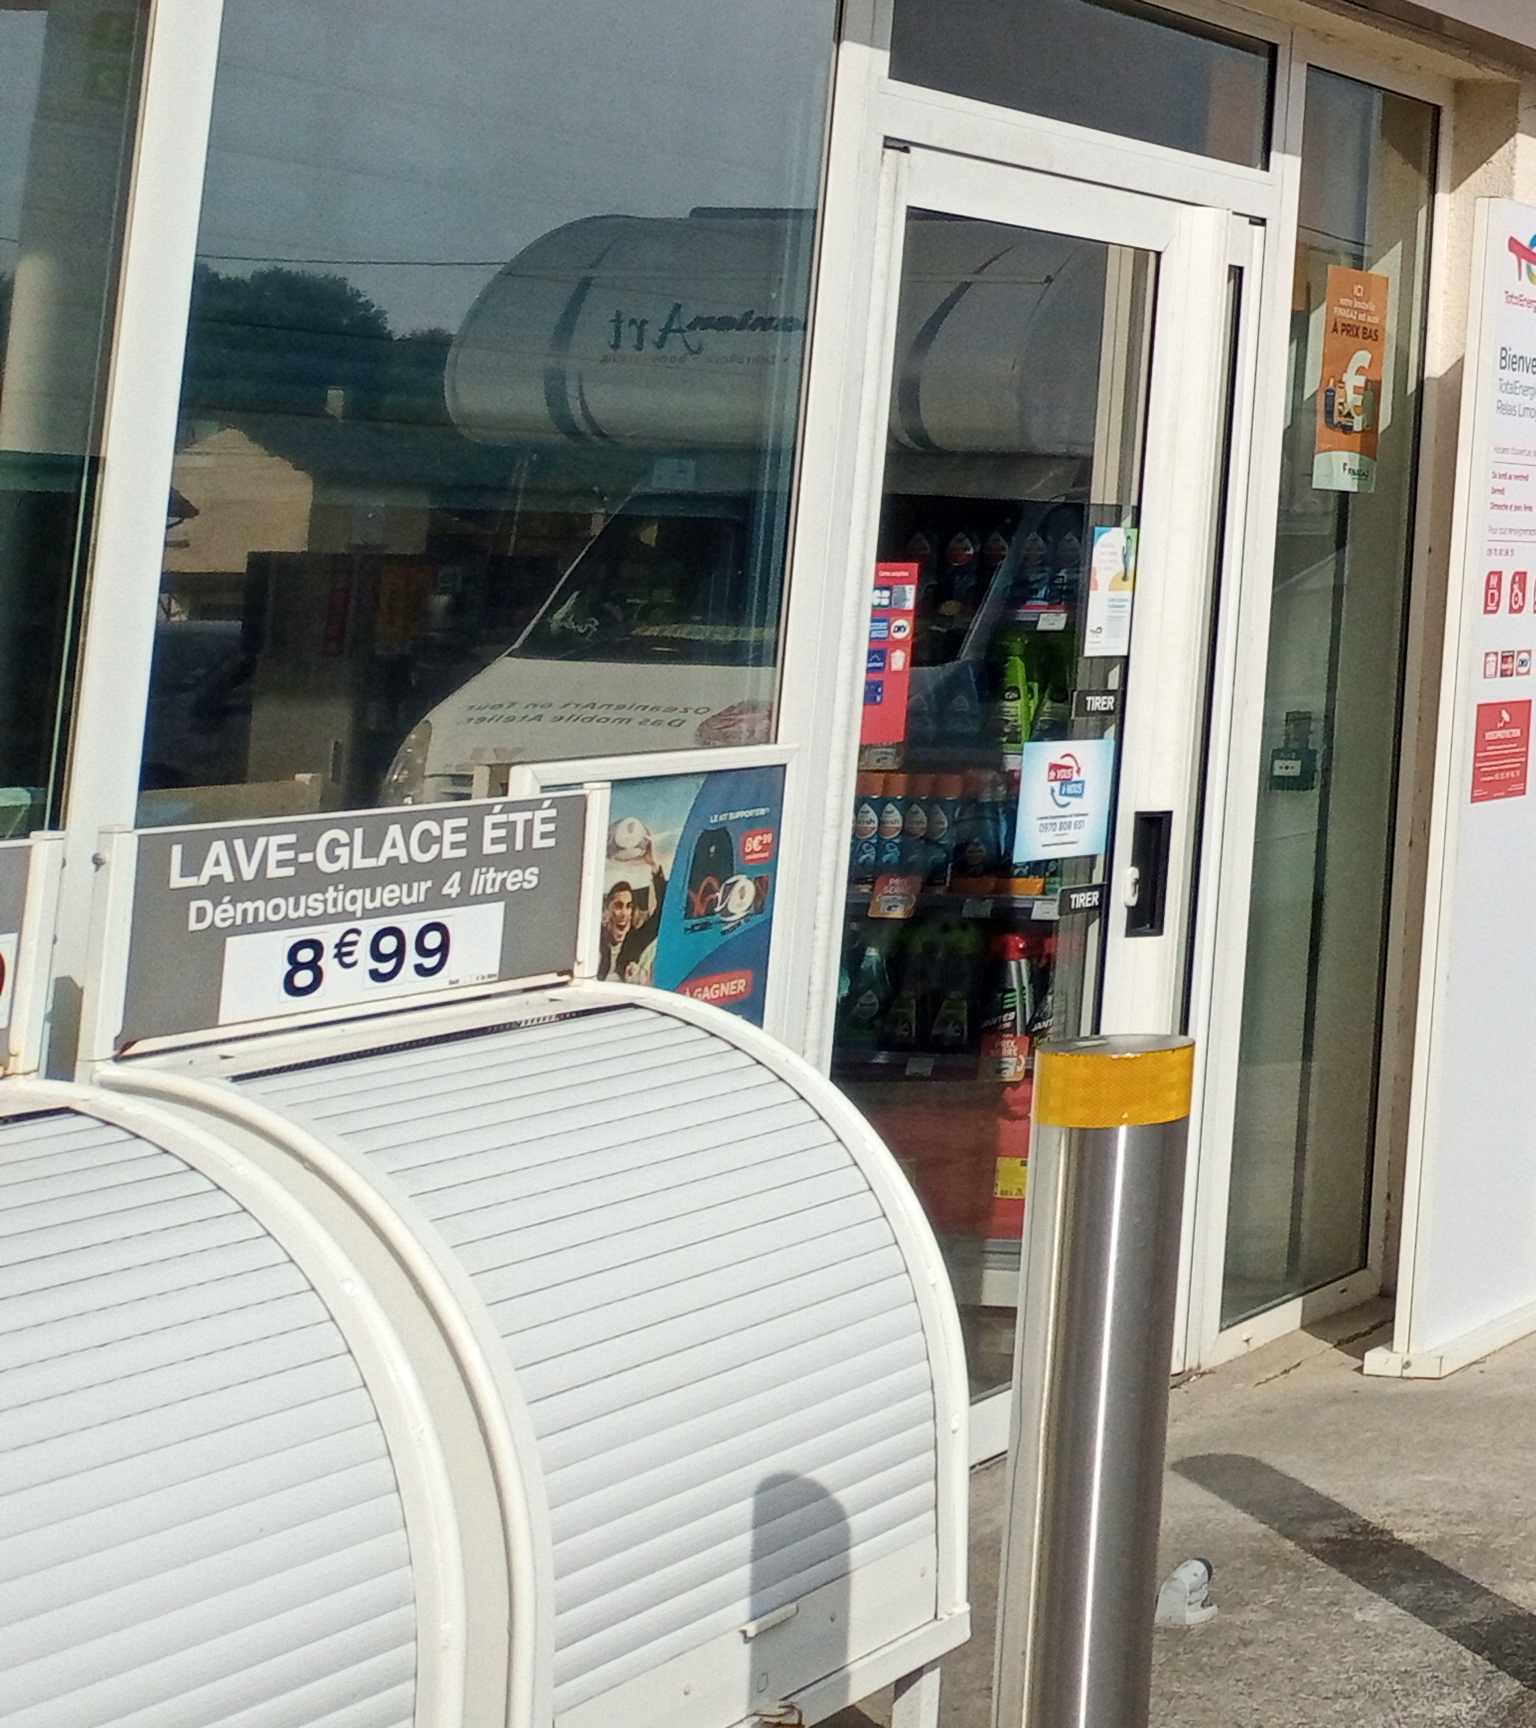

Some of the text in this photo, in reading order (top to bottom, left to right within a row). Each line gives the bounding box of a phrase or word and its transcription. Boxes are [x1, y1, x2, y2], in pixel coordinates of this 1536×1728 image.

[1341, 322, 1361, 339] PRIX
[1361, 326, 1379, 342] BAS
[1085, 695, 1115, 712] TIRER
[168, 800, 558, 890] LAVE-GLACE ÉTÉ
[188, 866, 540, 932] Démoustiqueur 4 litres
[1069, 890, 1100, 910] TIRER
[282, 920, 452, 999] 8€99
[692, 979, 747, 1001] GAGNER
